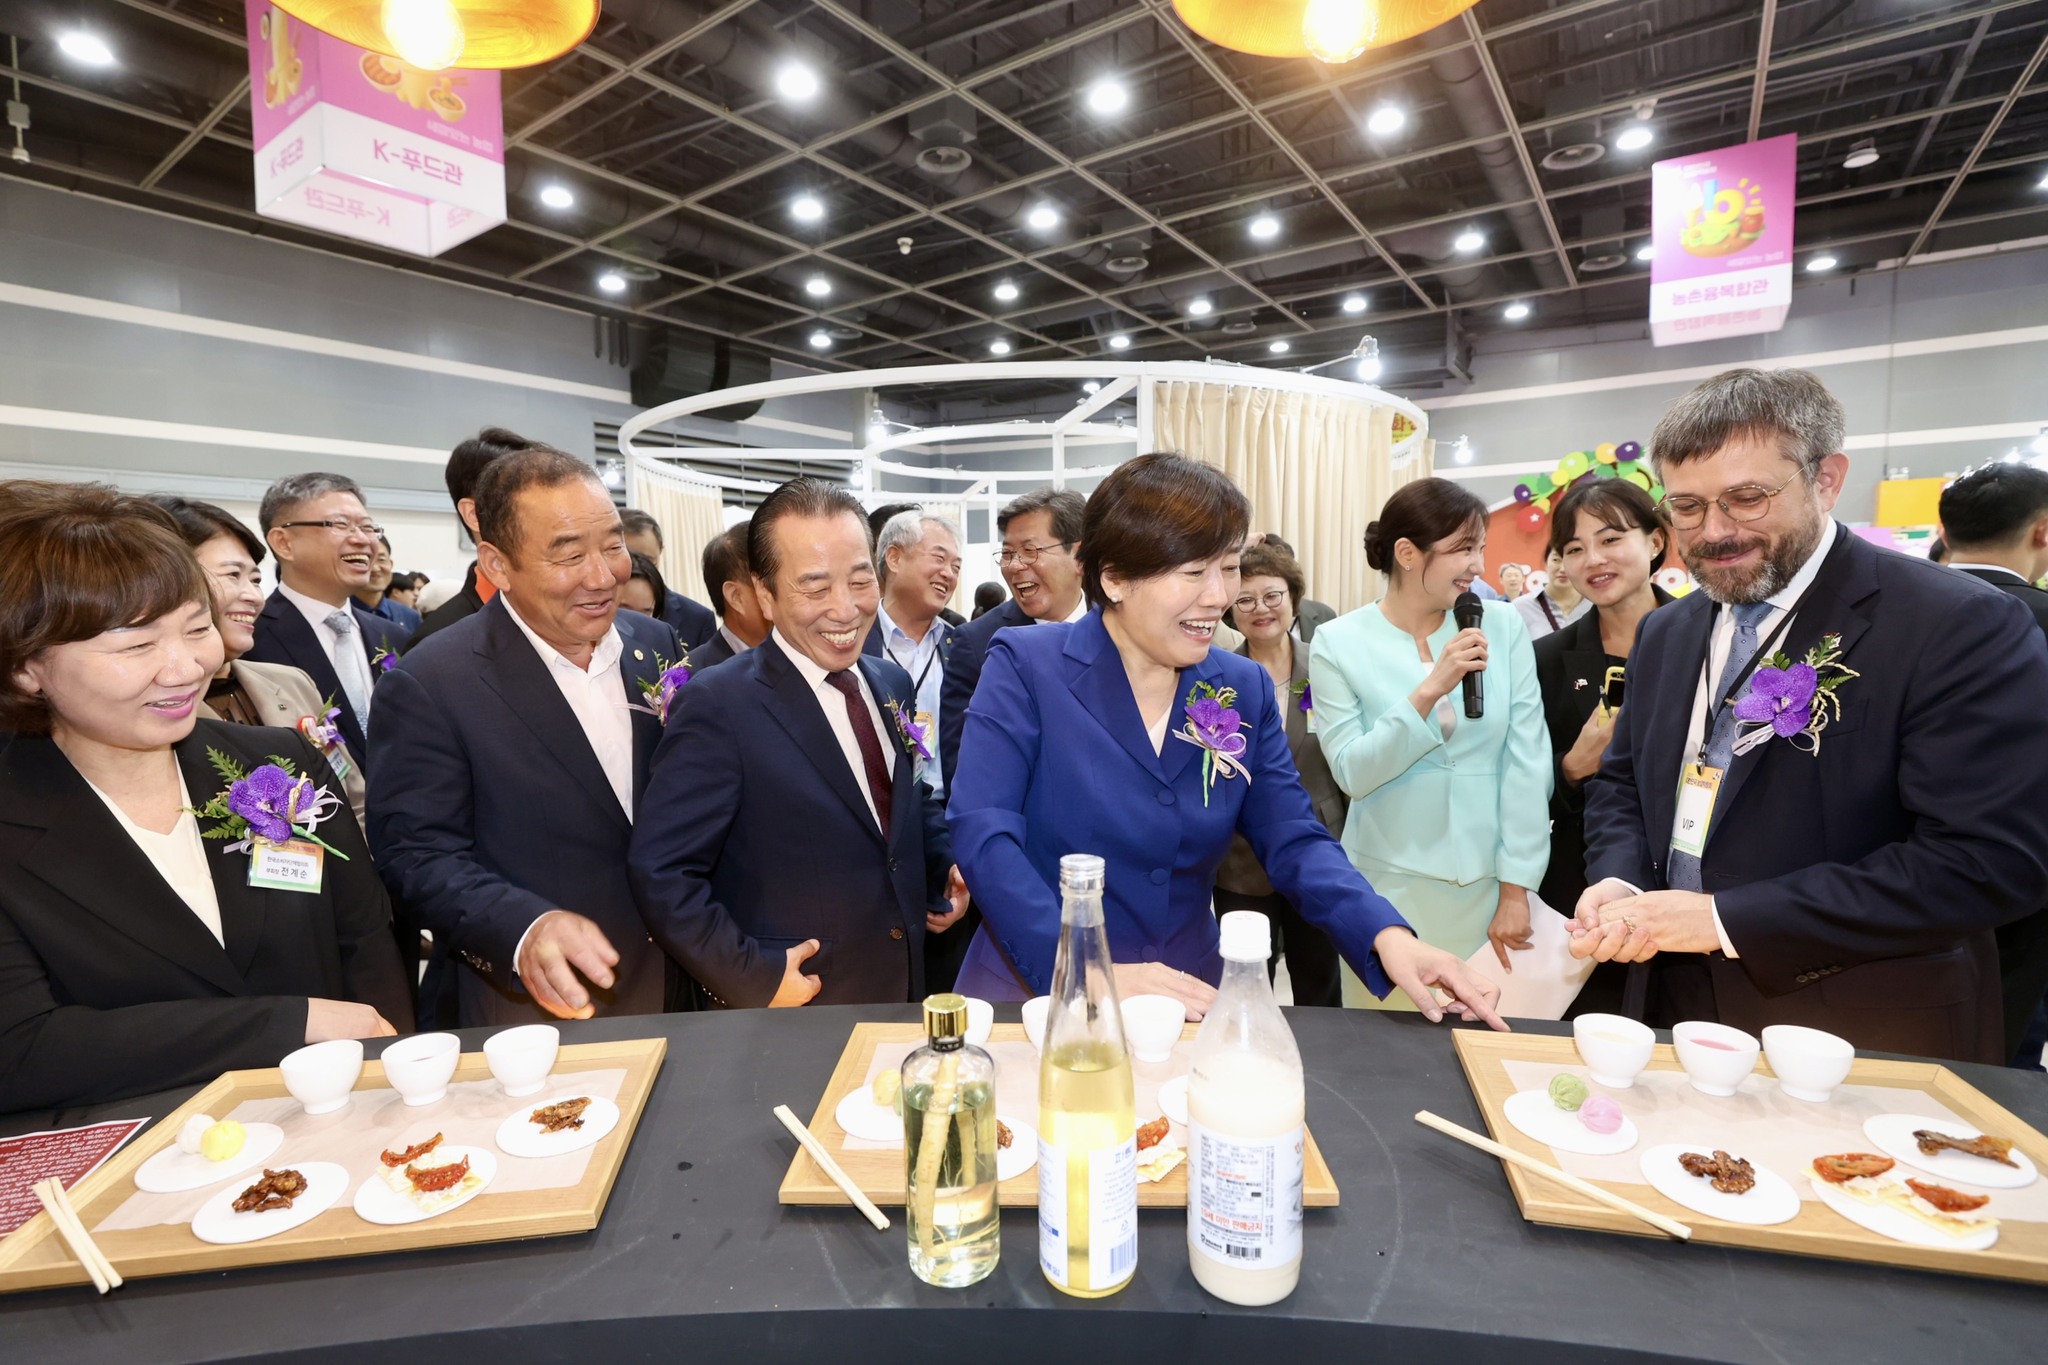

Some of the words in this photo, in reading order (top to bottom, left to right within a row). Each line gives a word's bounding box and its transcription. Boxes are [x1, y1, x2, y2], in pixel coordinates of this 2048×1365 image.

[373, 138, 464, 186] K-푸드관
[1672, 279, 1769, 306] 농촌융복합관
[1683, 818, 1695, 830] VIP
